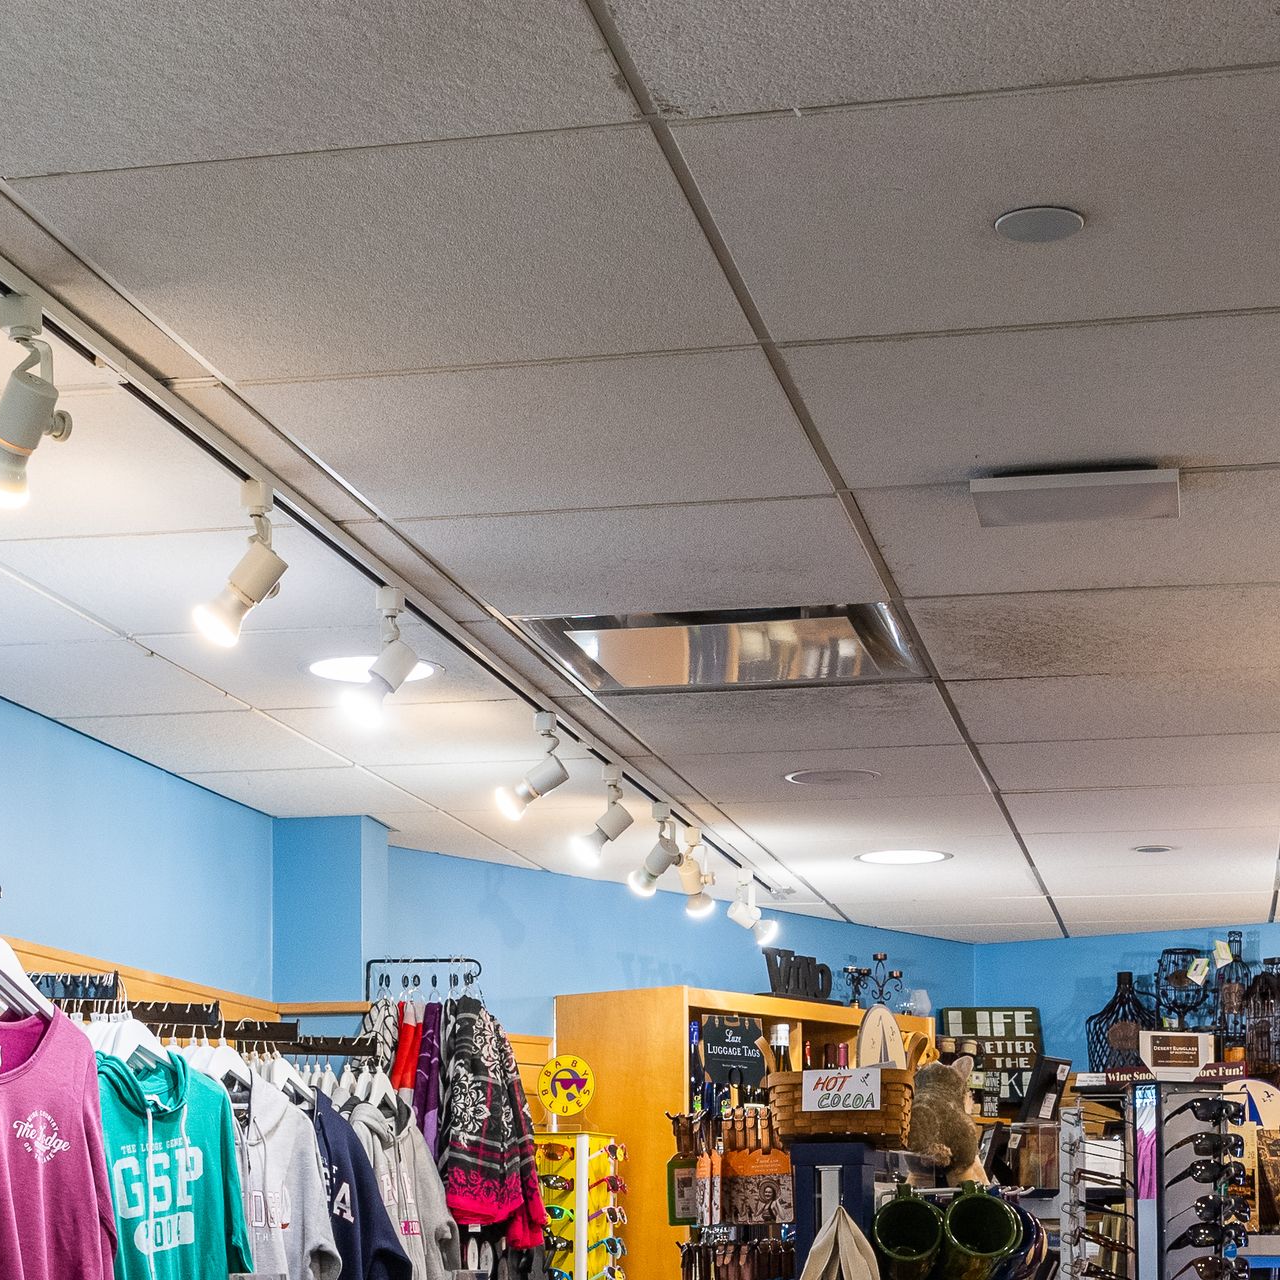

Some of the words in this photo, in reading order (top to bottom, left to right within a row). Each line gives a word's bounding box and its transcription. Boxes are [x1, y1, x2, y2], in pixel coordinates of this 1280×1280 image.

[948, 1010, 1035, 1037] LIFE
[707, 1043, 742, 1057] LUGGAGE
[742, 1044, 761, 1058] TAGS
[985, 1040, 1037, 1055] ETTER
[544, 1060, 589, 1077] BABY
[992, 1057, 1031, 1069] THE
[1218, 1065, 1244, 1078] Fun!
[813, 1073, 853, 1092] HOT
[1107, 1073, 1132, 1082] Wine
[541, 1089, 590, 1113] BLUES
[817, 1091, 875, 1110] COCOA
[13, 1120, 36, 1139] The
[121, 1143, 136, 1155] THE
[113, 1146, 203, 1219] GSP
